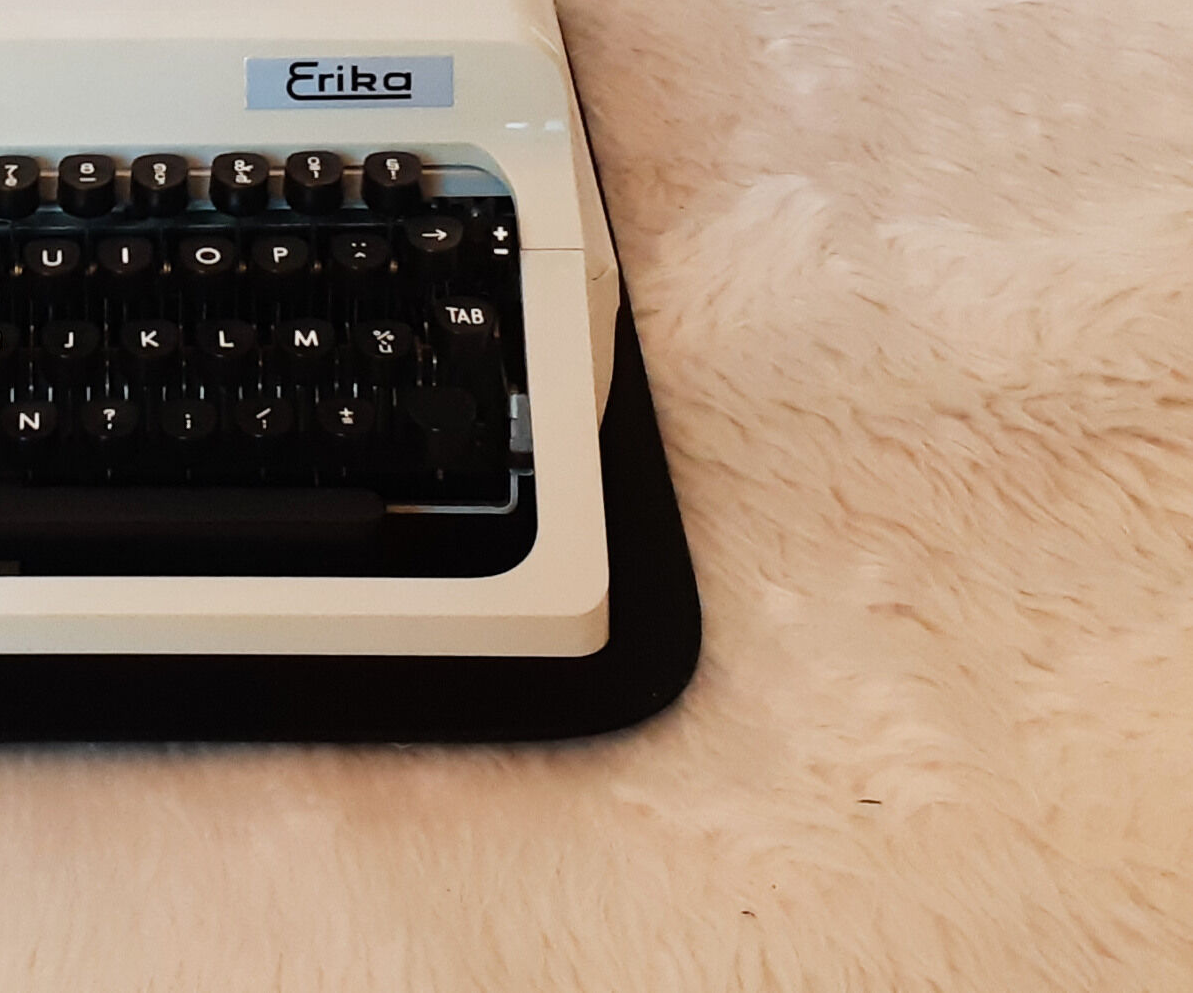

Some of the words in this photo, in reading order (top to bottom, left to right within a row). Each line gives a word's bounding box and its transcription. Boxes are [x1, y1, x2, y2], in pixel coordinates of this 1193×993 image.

[286, 61, 412, 101] Erika
[41, 250, 63, 267] U
[273, 246, 289, 263] P
[445, 306, 485, 326] TAB
[63, 331, 75, 349] J
[140, 330, 160, 348] K
[218, 330, 235, 348] L
[294, 330, 319, 347] M
[19, 412, 40, 430] N
